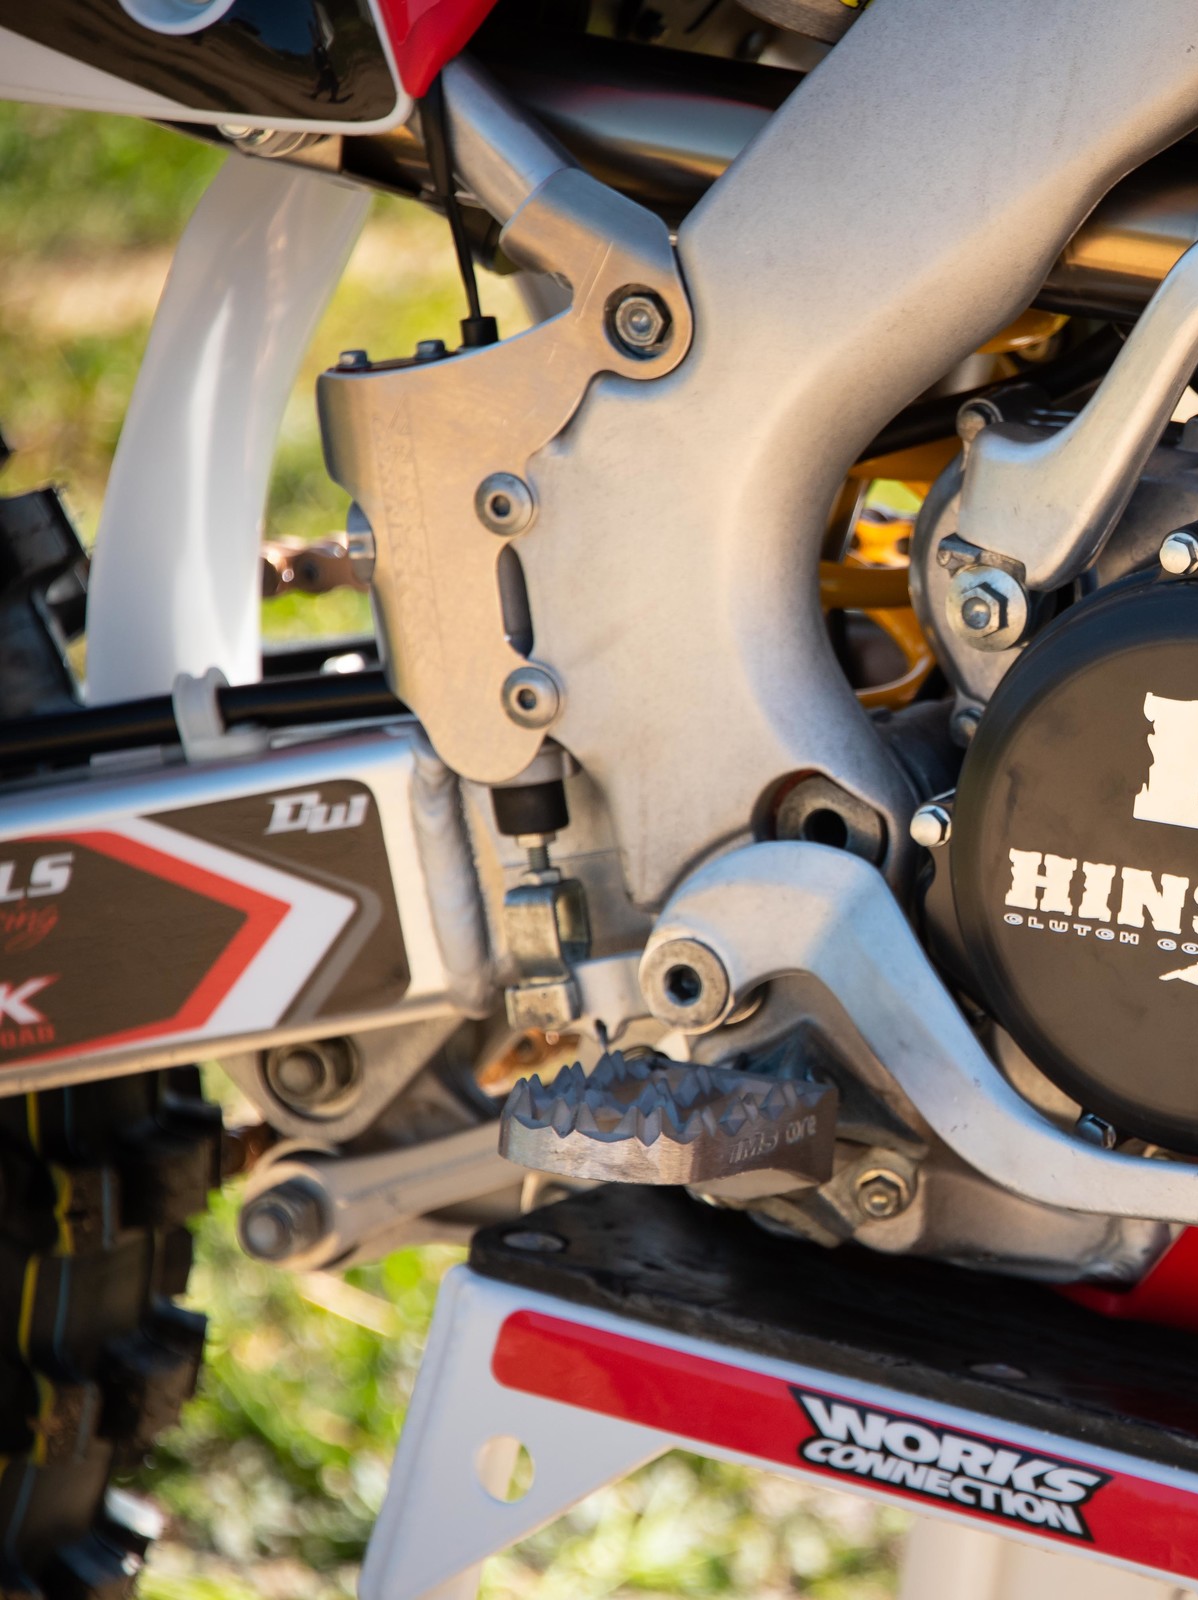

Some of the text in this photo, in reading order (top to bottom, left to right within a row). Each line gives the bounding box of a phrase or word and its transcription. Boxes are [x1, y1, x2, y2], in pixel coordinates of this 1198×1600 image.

[1003, 912, 1139, 946] CLUTCH
[800, 1393, 1102, 1502] WORKS
[803, 1437, 1084, 1536] CONNECTION
